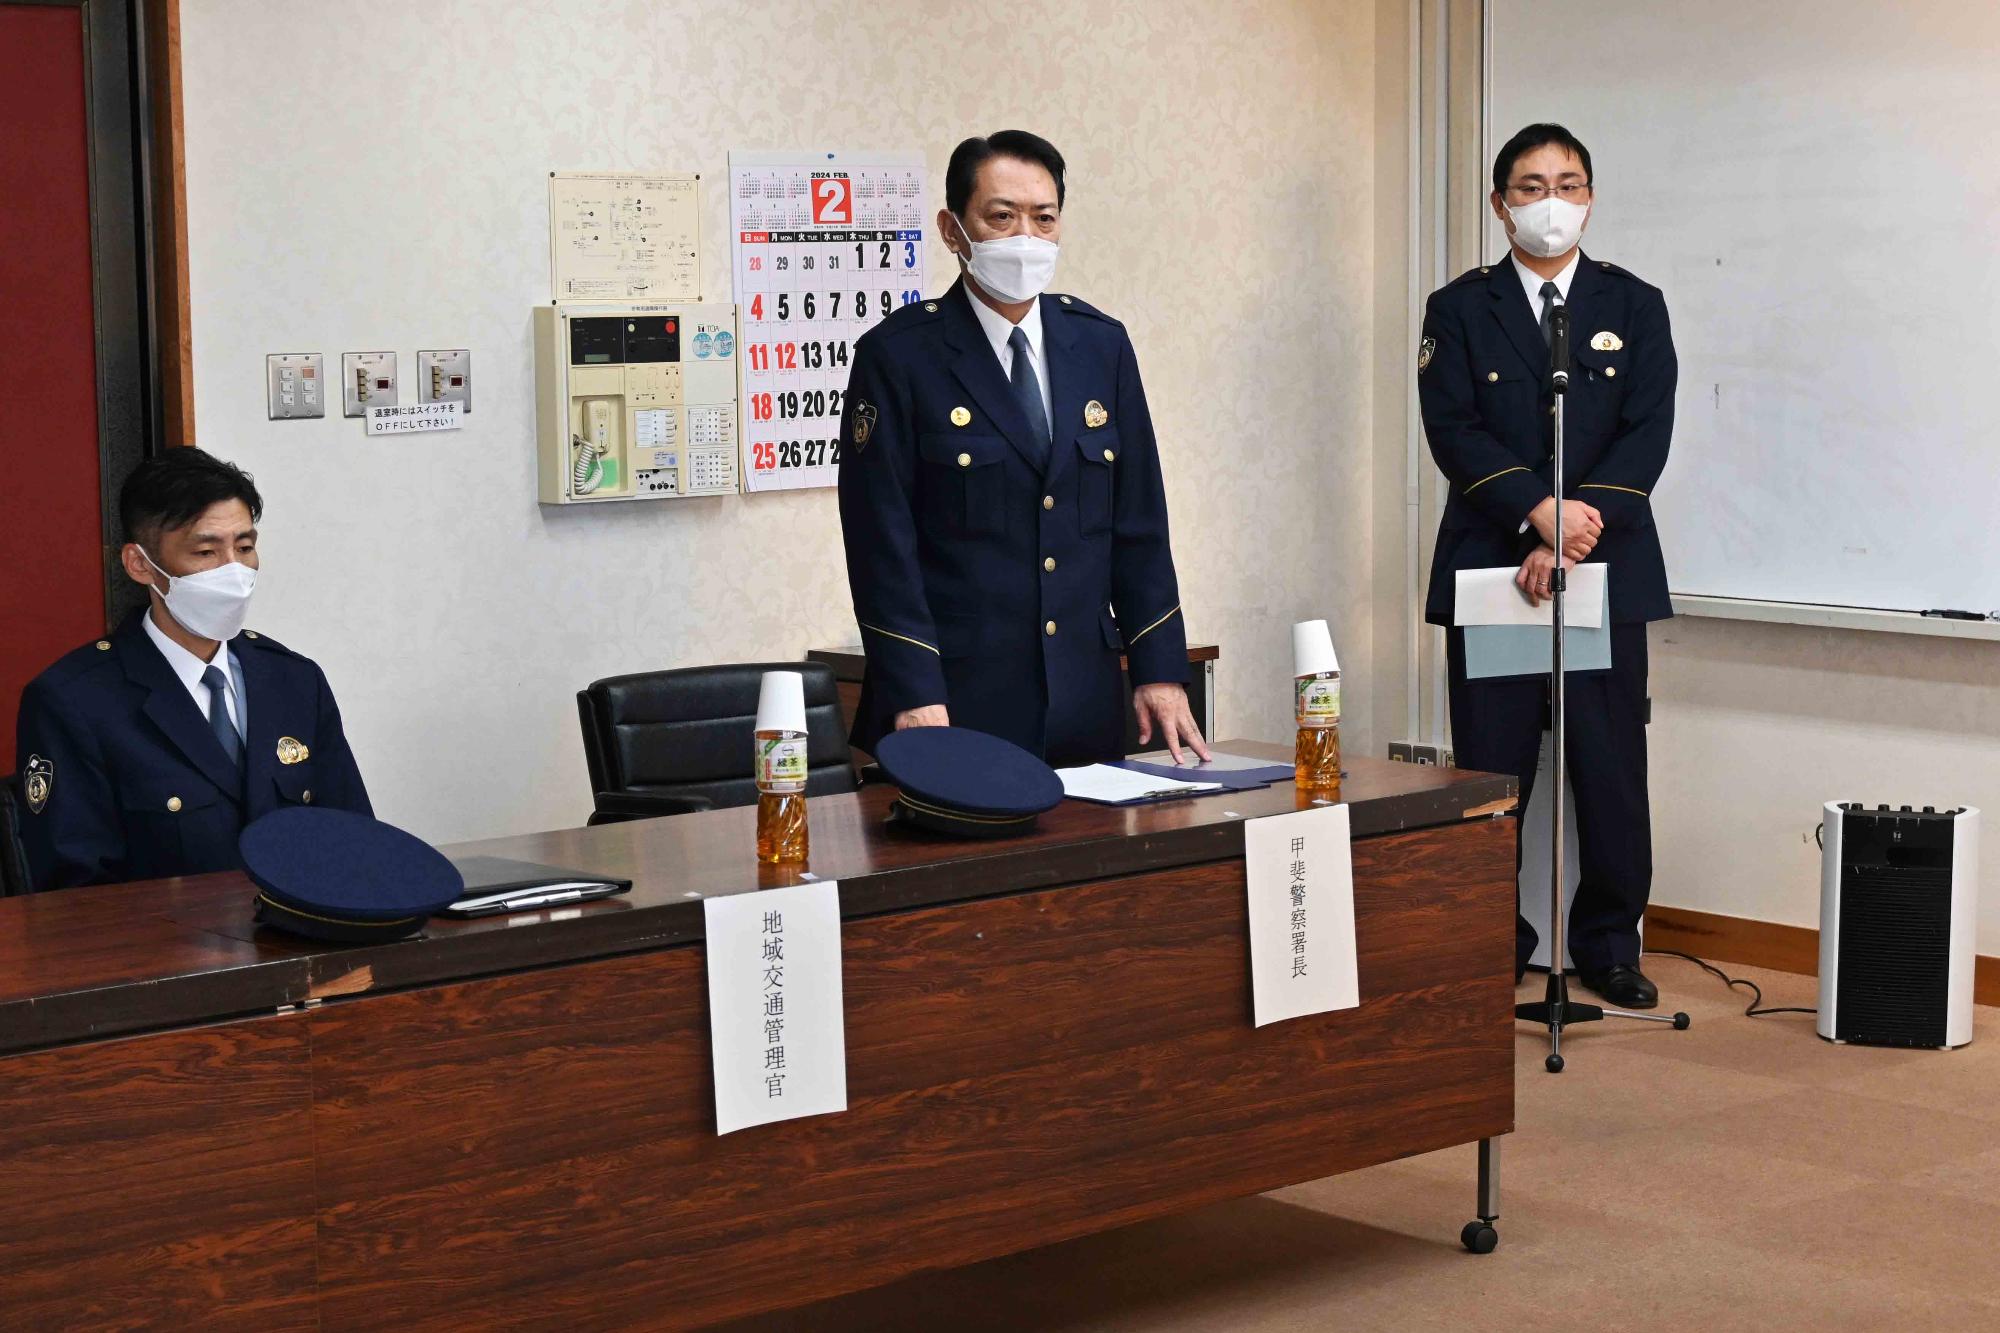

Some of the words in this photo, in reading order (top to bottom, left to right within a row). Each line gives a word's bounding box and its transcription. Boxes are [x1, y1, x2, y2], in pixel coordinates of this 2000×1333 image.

[818, 180, 846, 221] 2
[744, 233, 752, 242] 日
[771, 232, 778, 242] 月
[798, 232, 805, 241] 火
[823, 232, 831, 241] 水
[849, 232, 857, 240] 木
[876, 232, 883, 240] 金
[900, 231, 907, 240] 土
[749, 257, 761, 270] 28
[776, 256, 788, 270] 29
[803, 256, 814, 270] 30
[829, 256, 839, 269] 31
[855, 243, 864, 268] 1
[879, 242, 891, 268] 2
[904, 242, 915, 268] 3
[750, 294, 763, 320] 4
[778, 294, 789, 320] 5
[804, 292, 816, 319] 6
[829, 292, 841, 318] 7
[855, 291, 866, 318] 8
[880, 290, 892, 317] 9
[748, 344, 769, 370] 11
[775, 342, 797, 369] 12
[801, 342, 822, 368] 13
[827, 341, 848, 367] 14
[374, 404, 455, 418] 退室時にはスイッチを
[751, 392, 772, 420] 18
[778, 391, 798, 418] 19
[802, 390, 824, 417] 20
[753, 442, 776, 470] 25
[778, 441, 802, 468] 26
[804, 440, 826, 466] 27
[1310, 695, 1330, 705] 緑茶
[777, 757, 798, 767] 緑茶
[1290, 836, 1308, 980] 甲斐警察署長
[762, 909, 786, 1098] 地域交通管理官
